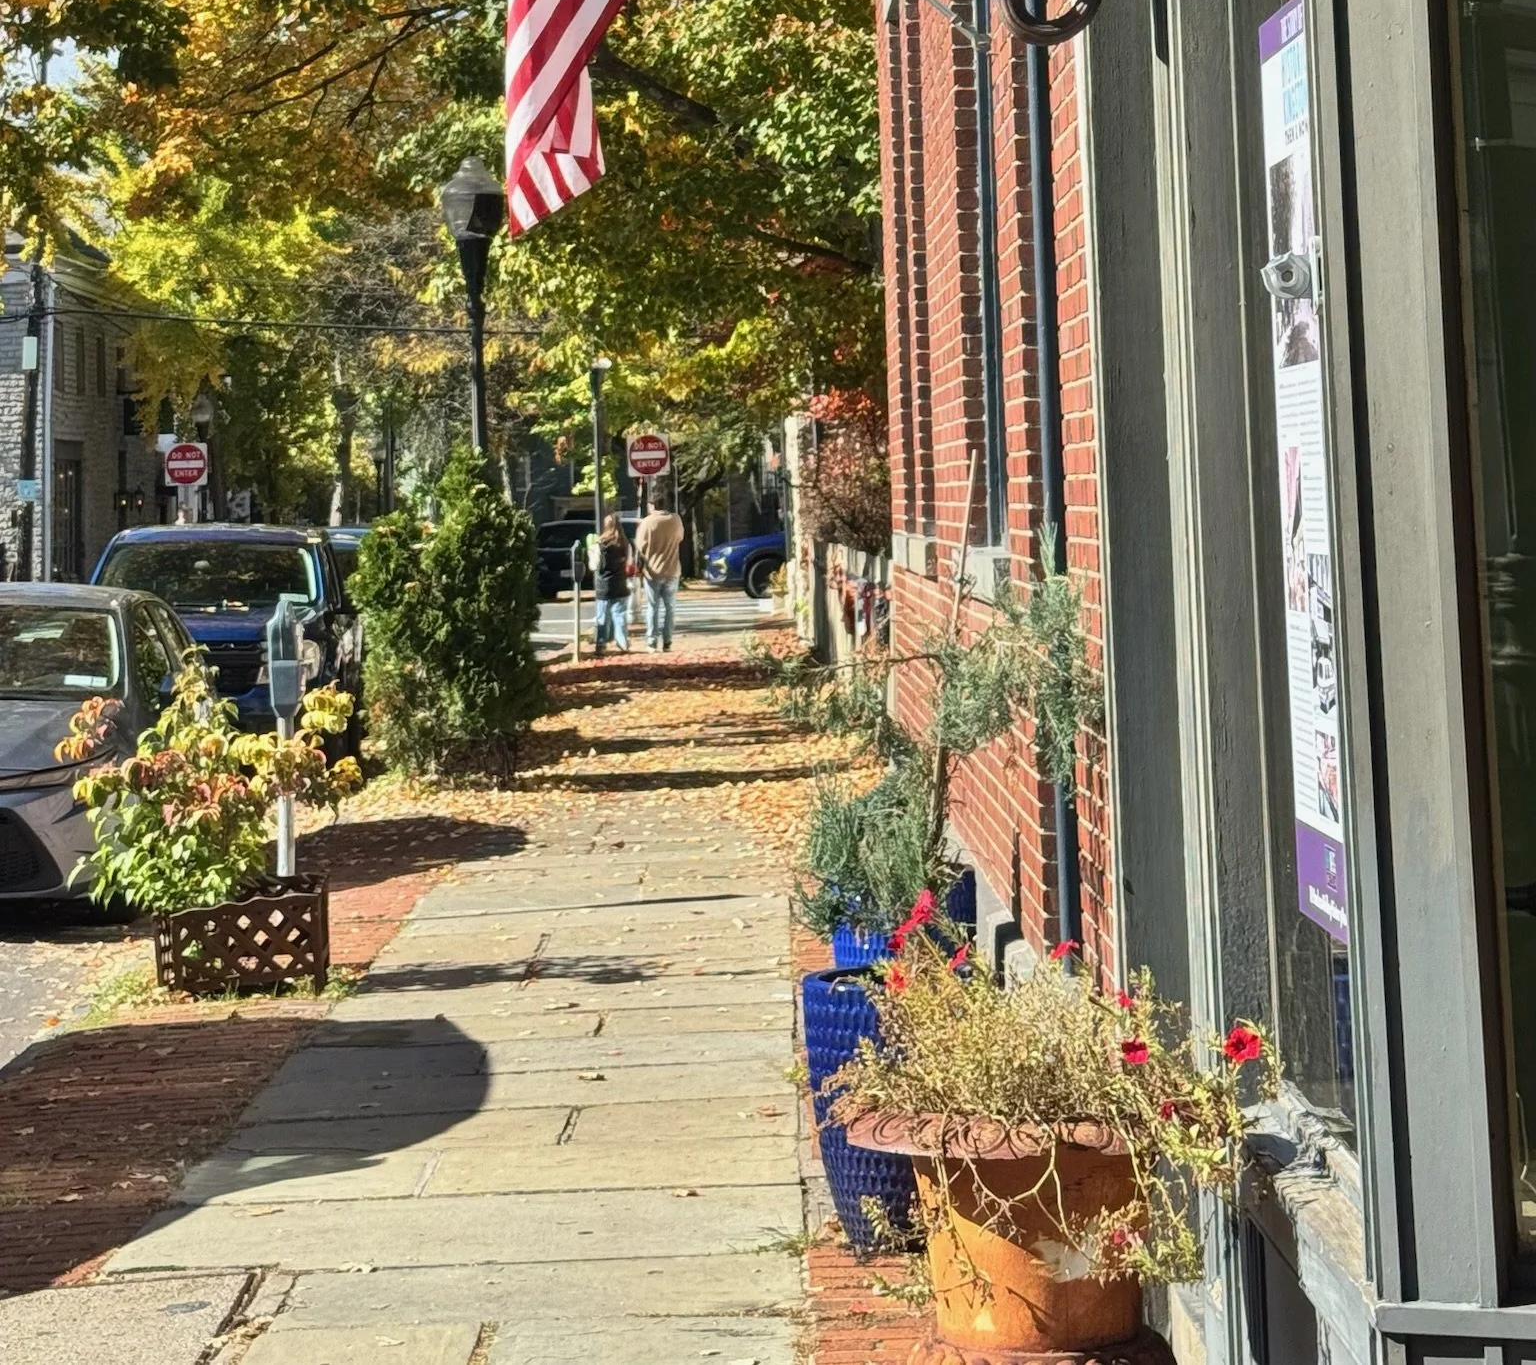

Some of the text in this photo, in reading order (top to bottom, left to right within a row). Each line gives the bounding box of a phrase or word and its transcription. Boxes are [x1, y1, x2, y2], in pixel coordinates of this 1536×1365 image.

[634, 442, 663, 450] DO NOT
[171, 451, 201, 459] DO NOT
[637, 460, 660, 468] ENTER
[174, 469, 198, 477] ENTER
